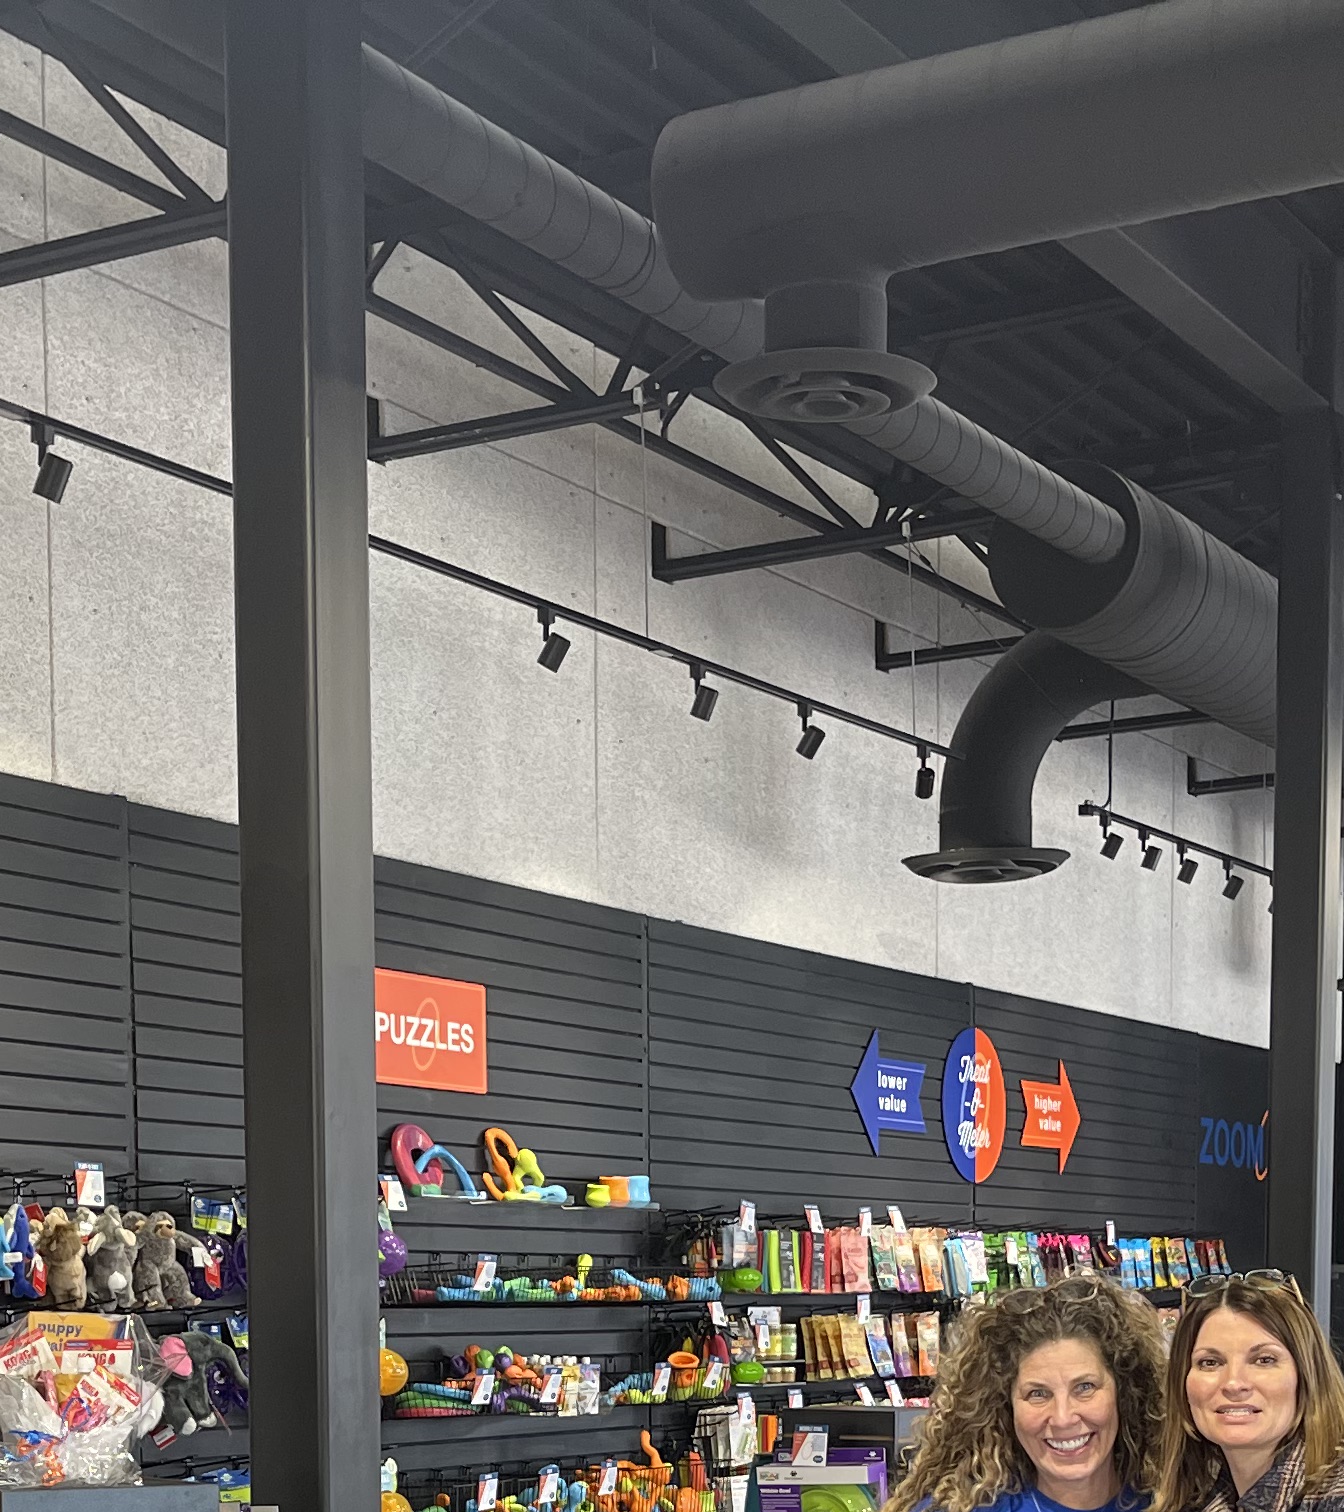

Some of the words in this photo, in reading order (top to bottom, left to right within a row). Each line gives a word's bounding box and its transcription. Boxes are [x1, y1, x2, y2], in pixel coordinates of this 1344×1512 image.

[375, 1011, 475, 1054] PUZZLES
[959, 1054, 991, 1085] Treat
[877, 1071, 908, 1091] lower
[878, 1094, 908, 1112] value
[1034, 1094, 1062, 1112] higher
[1038, 1115, 1062, 1132] value
[957, 1120, 991, 1150] Meter
[1199, 1117, 1265, 1169] ZOOM
[38, 1323, 84, 1337] puppy
